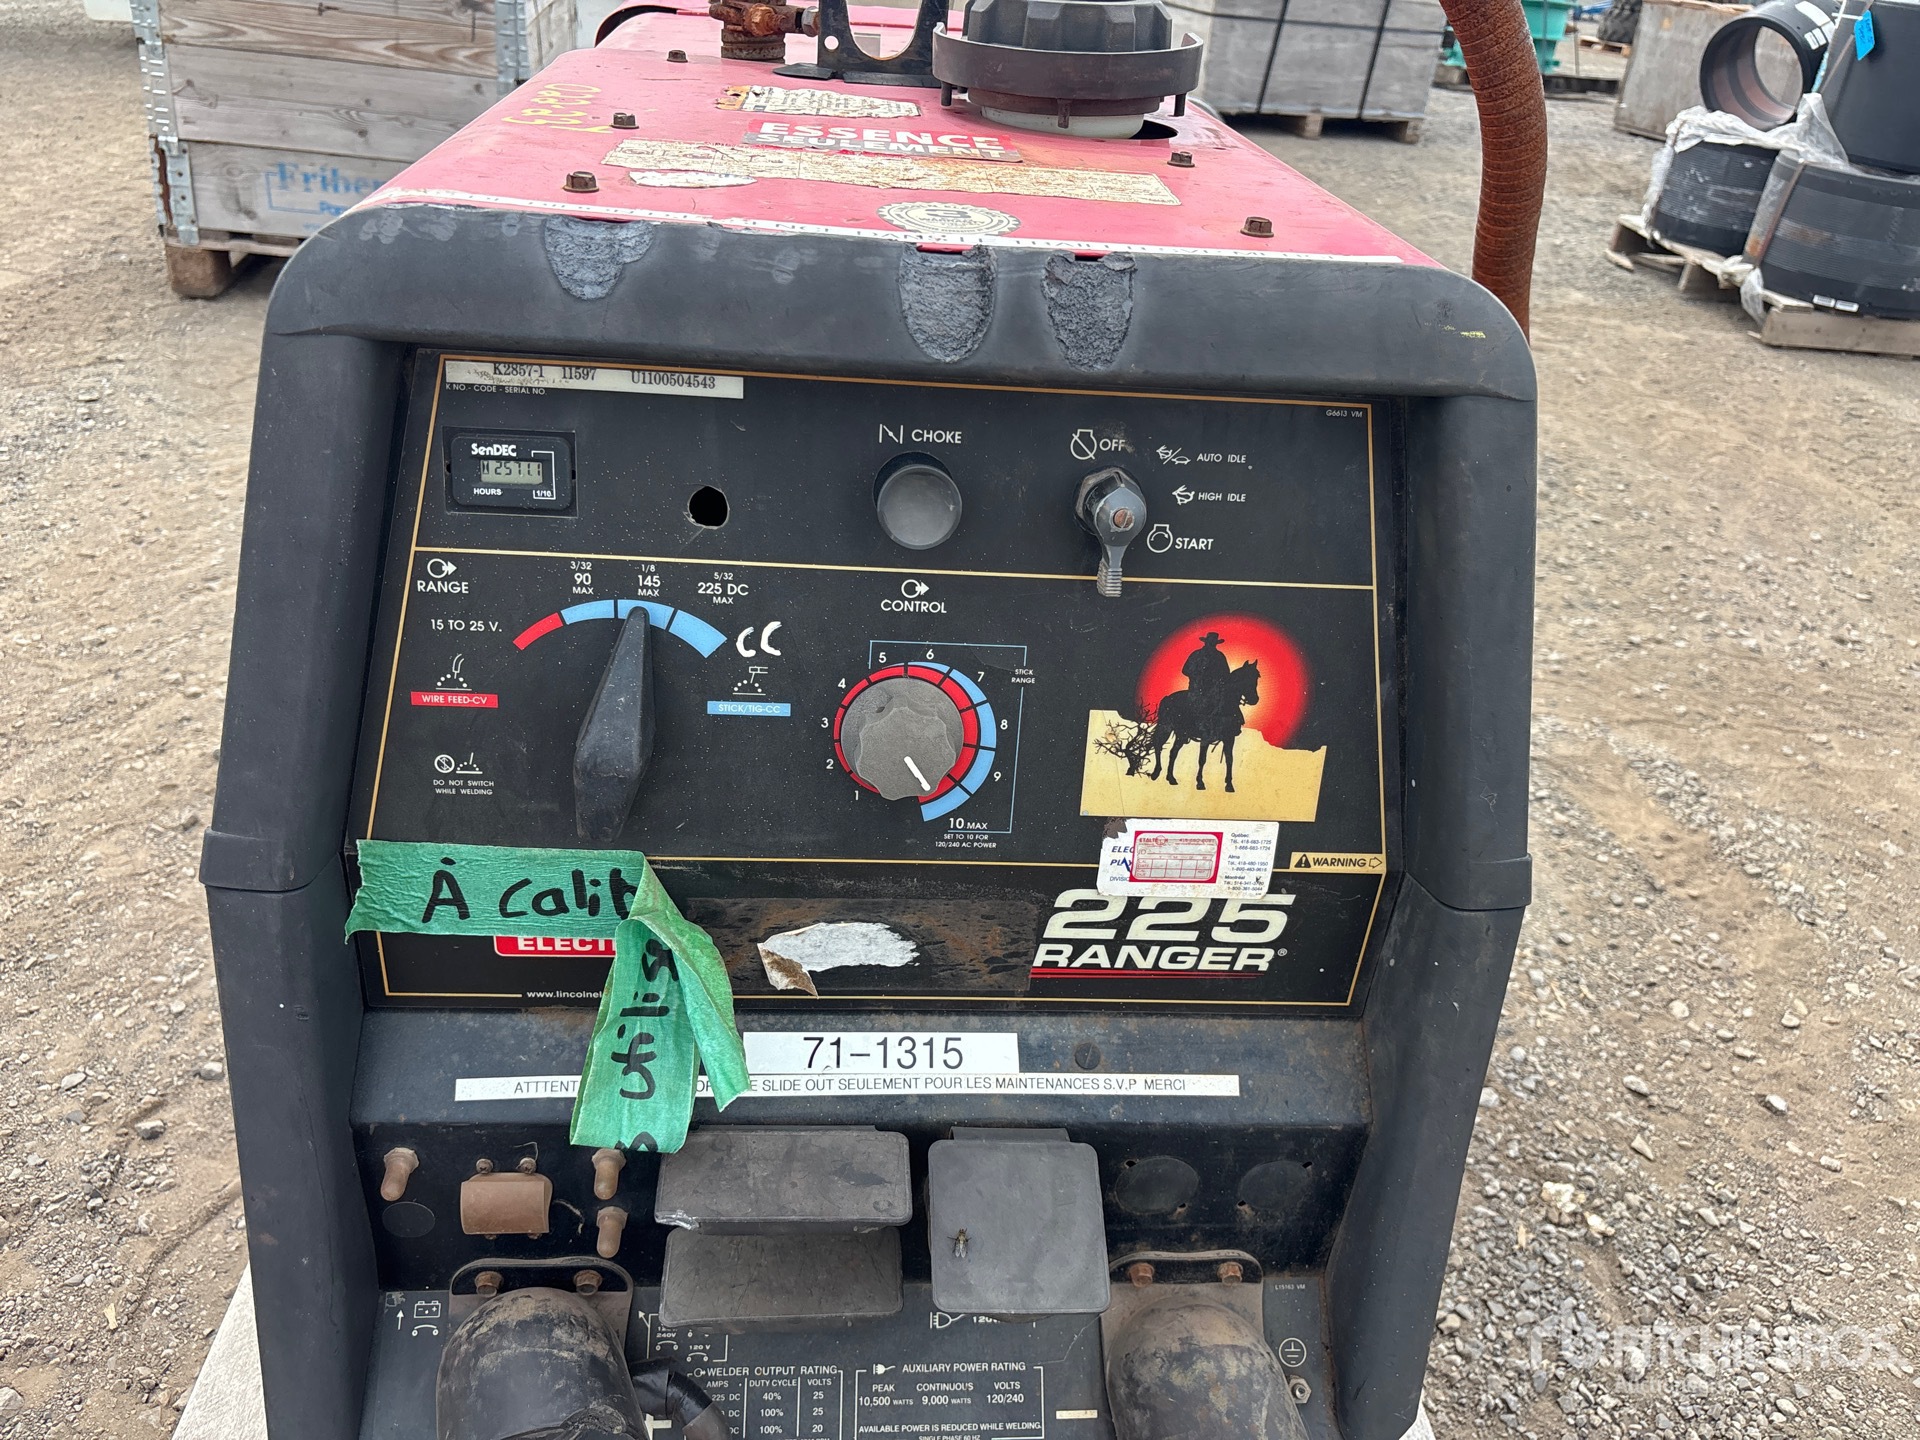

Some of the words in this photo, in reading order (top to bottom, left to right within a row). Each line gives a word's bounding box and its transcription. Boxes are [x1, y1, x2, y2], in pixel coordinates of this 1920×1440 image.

[760, 122, 1000, 148] ESSENCE
[756, 133, 1004, 158] SEULEMENT
[494, 363, 543, 378] K2857-1
[562, 366, 597, 380] 11597
[631, 370, 716, 389] U1100504543
[911, 429, 962, 443] CHOKE
[471, 443, 516, 457] SenDEC
[1099, 439, 1125, 451] OFF
[1196, 453, 1222, 462] AUTO
[1227, 454, 1246, 464] IDLE
[473, 488, 502, 496] HOURS
[1198, 492, 1222, 501] HIGH
[1227, 493, 1246, 502] IDLE
[1175, 538, 1213, 550] START
[570, 561, 592, 570] 3/32
[641, 564, 656, 572] 1/8
[574, 573, 592, 585] 90
[637, 575, 661, 587] 145
[713, 572, 733, 581] 5/32
[417, 580, 469, 593] RANGE
[572, 587, 594, 595] MAX
[698, 583, 722, 595] 225
[727, 583, 749, 596] DC
[637, 588, 660, 597] MAX
[712, 597, 734, 605] MAX
[880, 599, 947, 613] CONTROL
[431, 619, 444, 630] 15
[449, 620, 465, 631] TO
[469, 620, 485, 632] 25
[878, 652, 887, 663] 5
[926, 649, 934, 660] 6
[977, 671, 985, 682] 7
[1011, 676, 1036, 684] RANGE
[838, 678, 846, 689] 4
[422, 695, 445, 703] WIRE
[448, 695, 488, 704] FEED-CV
[718, 703, 781, 714] STICK/TIG-CC
[821, 718, 829, 728] 3
[1000, 719, 1008, 730] 8
[826, 759, 834, 769] 2
[994, 771, 1002, 782] 9
[460, 788, 493, 796] WELDING
[854, 790, 859, 800] 1
[949, 817, 965, 829] 10
[966, 822, 988, 830] MAX
[1312, 857, 1367, 867] WARNING
[1043, 888, 1296, 943] 225
[517, 936, 616, 951] ELECT
[802, 1036, 965, 1070] 71-1315
[761, 1079, 801, 1092] SLIDE
[804, 1078, 834, 1092] OUT
[838, 1077, 920, 1091] SEULEMENT
[924, 1077, 962, 1091] POUR
[966, 1077, 992, 1091] LES
[995, 1077, 1099, 1091] MAINTENANCES
[1144, 1078, 1186, 1091] MERCI
[707, 1367, 749, 1376] WELDER
[754, 1366, 795, 1376] OUTPUT
[801, 1365, 838, 1374] RATING
[902, 1363, 951, 1373] AUXILIARY
[954, 1362, 989, 1372] POWER
[991, 1362, 1026, 1371] RATING
[749, 1379, 770, 1387] DUTY
[807, 1378, 832, 1386] VOLTS
[872, 1384, 895, 1392] PEAK
[916, 1382, 974, 1391] CONTINUOUS
[994, 1382, 1021, 1390] VOLTS
[762, 1392, 782, 1400] 40%
[813, 1391, 824, 1399] 25
[859, 1397, 891, 1406] 10,500
[921, 1396, 949, 1405] 9,000
[986, 1394, 1025, 1404] 120/240
[760, 1408, 784, 1417] 100%
[812, 1407, 824, 1415] 25
[759, 1425, 783, 1434] 100%
[812, 1424, 823, 1432] 20
[859, 1425, 900, 1433] AVAILABLE
[901, 1424, 930, 1432] POWER
[941, 1423, 979, 1431] REDUCED
[980, 1423, 1004, 1431] WHILE
